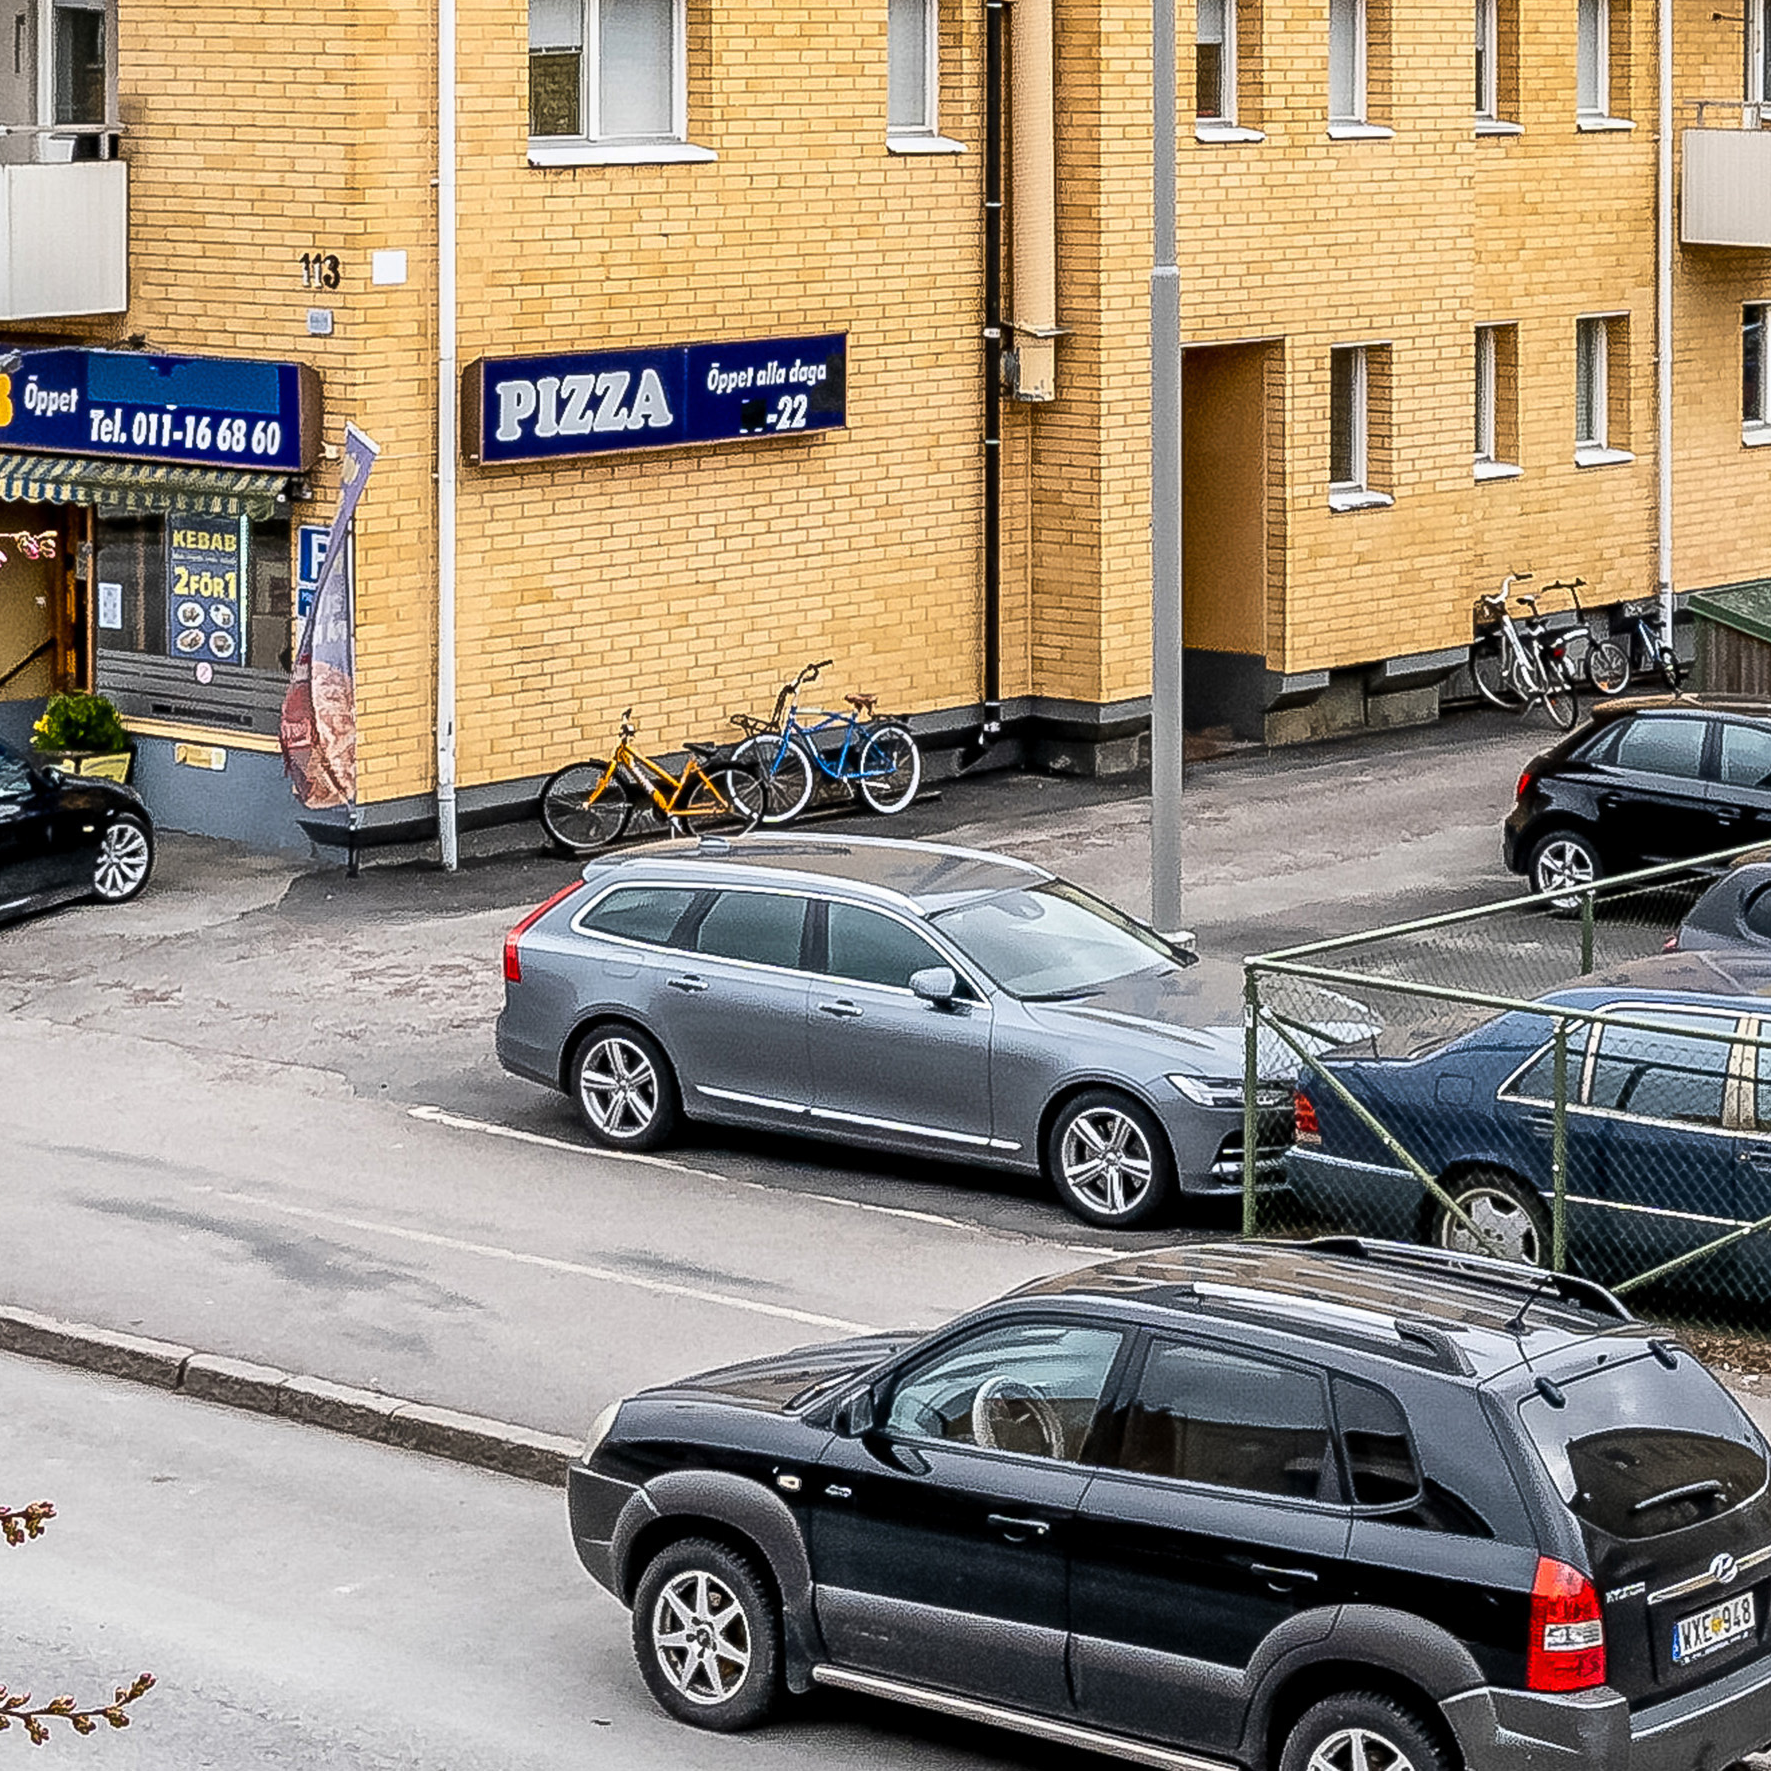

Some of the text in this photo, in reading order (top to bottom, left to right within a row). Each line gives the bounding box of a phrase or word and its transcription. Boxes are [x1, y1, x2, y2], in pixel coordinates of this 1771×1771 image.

[299, 253, 340, 289] 113
[24, 374, 79, 417] Öppet
[707, 362, 755, 395] Öppet
[756, 360, 787, 386] alla
[495, 368, 674, 442] PIZZA
[90, 407, 281, 456] Tel. 011-16 68 60
[172, 529, 237, 553] KEBAB
